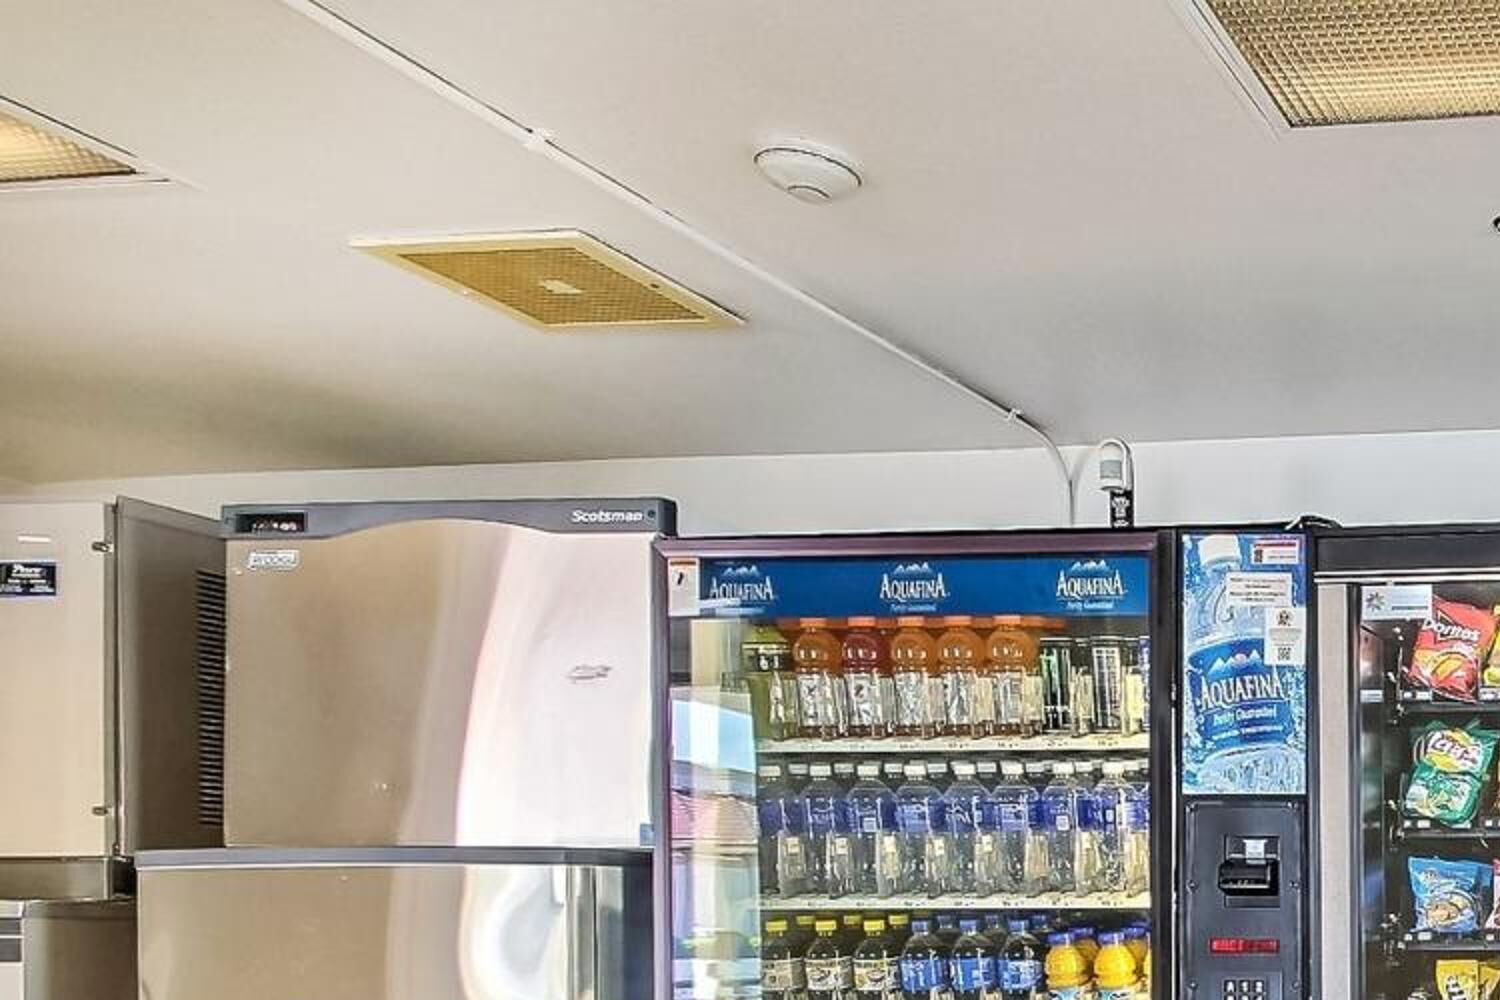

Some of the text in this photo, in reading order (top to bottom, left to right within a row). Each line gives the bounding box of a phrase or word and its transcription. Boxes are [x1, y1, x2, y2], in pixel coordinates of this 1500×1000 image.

[571, 509, 643, 523] Scotsman
[709, 575, 776, 601] AQUAFINA
[880, 572, 947, 602] AQUAFINA
[1055, 569, 1125, 600] AQUAFINA
[1422, 617, 1481, 643] Doritos
[1200, 666, 1287, 711] AQUAFINA
